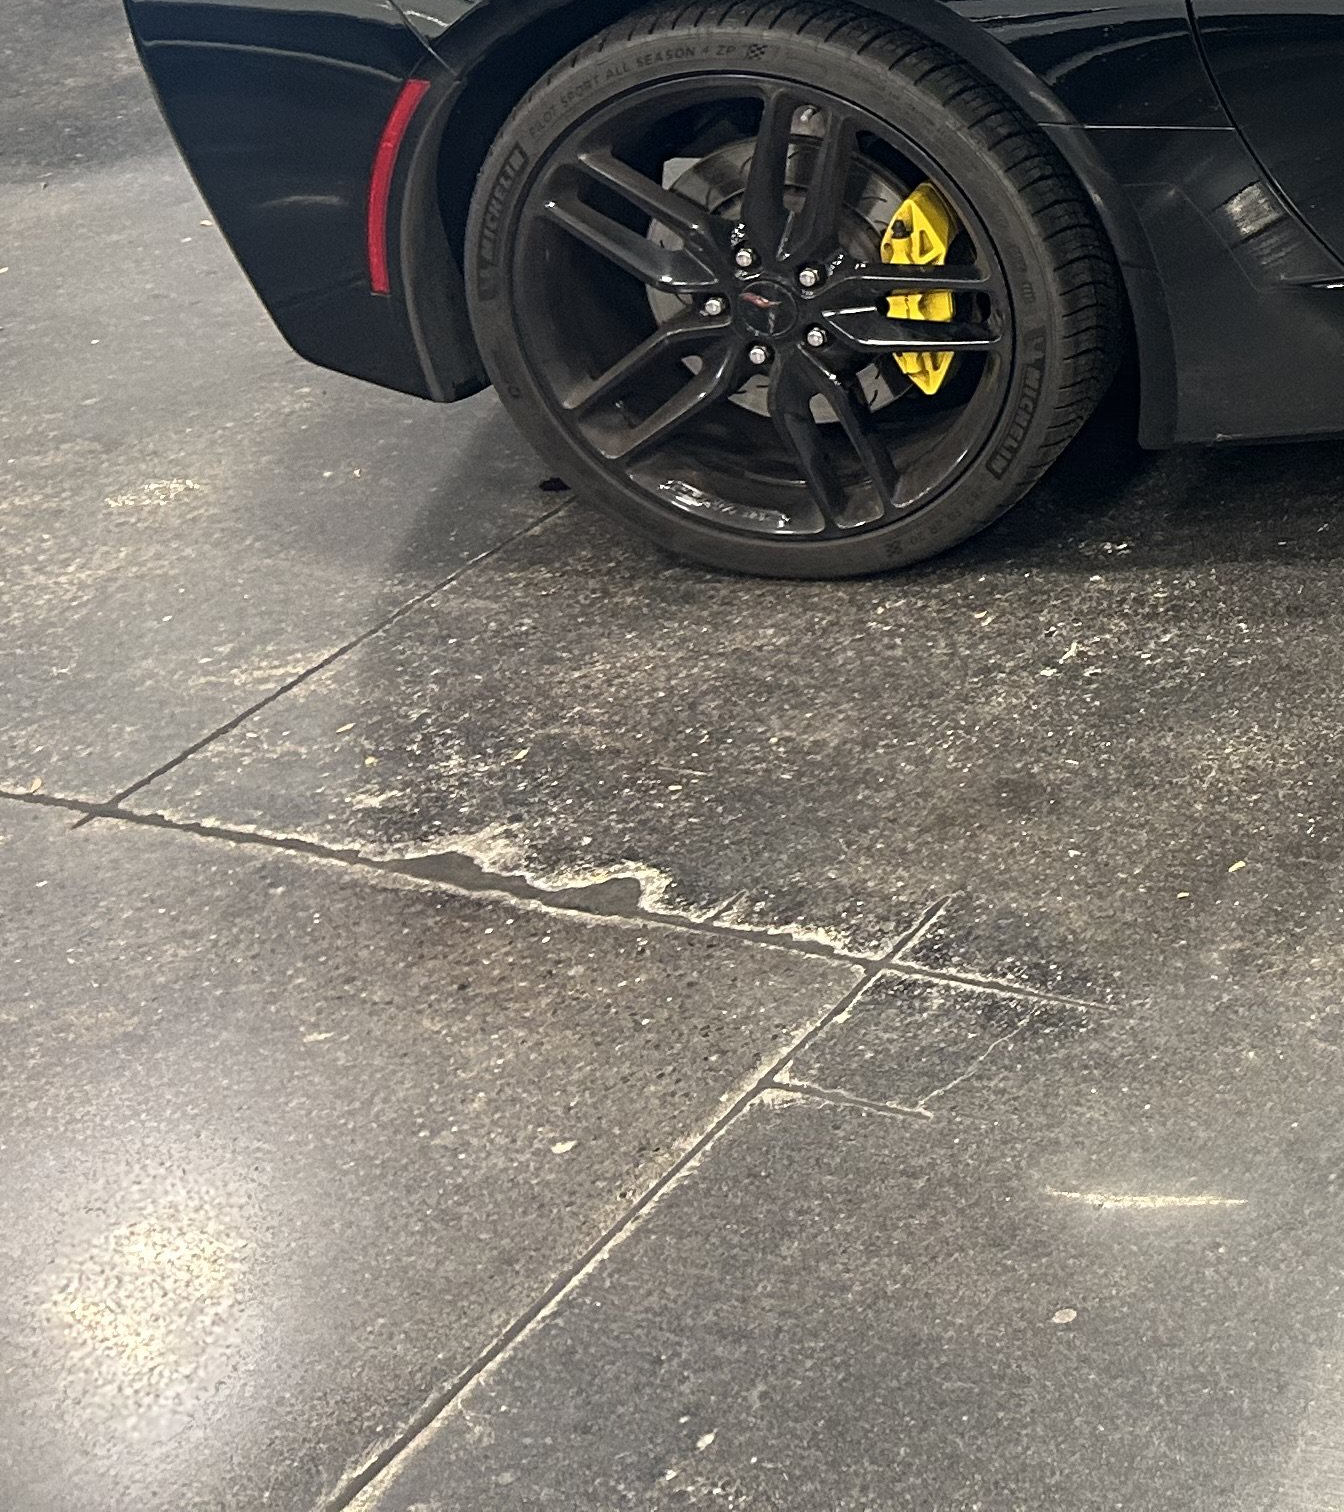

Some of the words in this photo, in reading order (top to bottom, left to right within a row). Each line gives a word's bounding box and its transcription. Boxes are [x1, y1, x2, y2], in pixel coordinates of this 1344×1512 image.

[560, 74, 600, 107] SPORT
[606, 62, 631, 81] ALL
[636, 47, 697, 68] SEASON
[480, 148, 526, 261] MICHELIN
[991, 366, 1042, 474] MICHELIN
